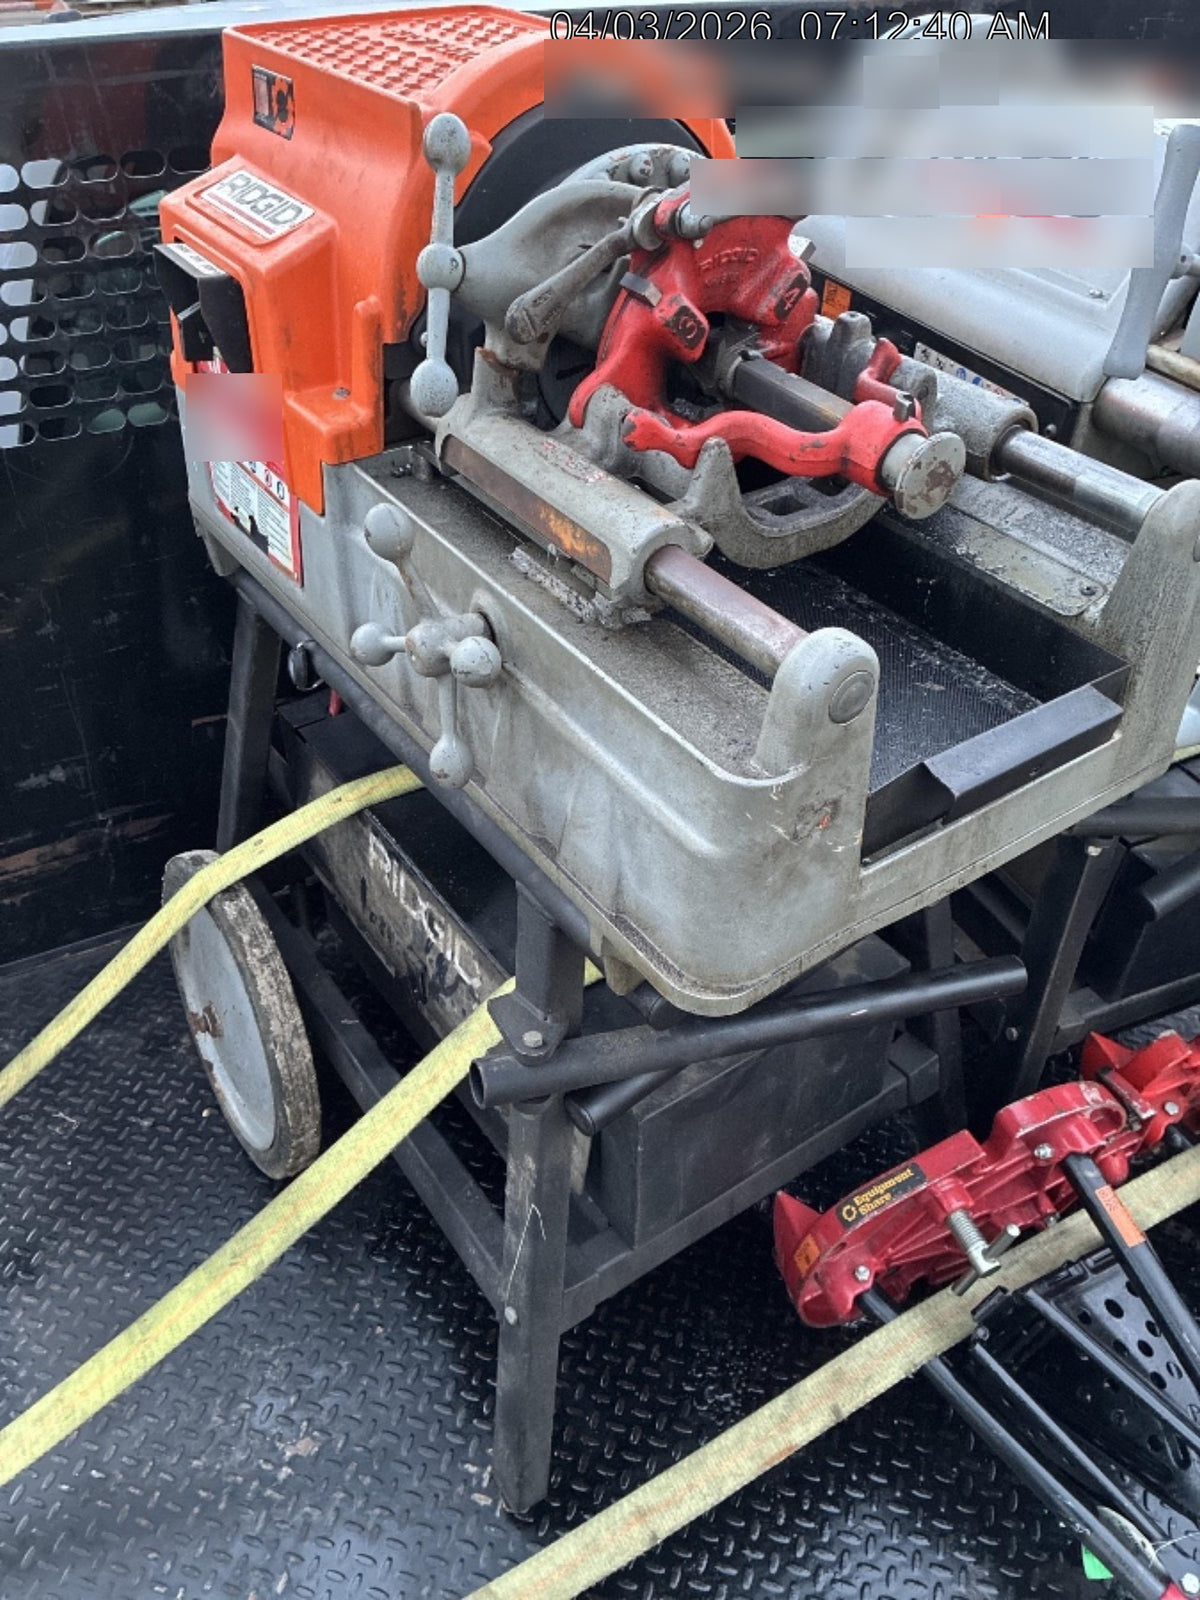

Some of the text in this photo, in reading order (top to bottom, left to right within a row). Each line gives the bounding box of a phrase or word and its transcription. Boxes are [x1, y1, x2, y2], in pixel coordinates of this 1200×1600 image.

[218, 173, 303, 225] RIDGID
[853, 1168, 914, 1206] Equipment
[858, 1192, 892, 1215] Share
